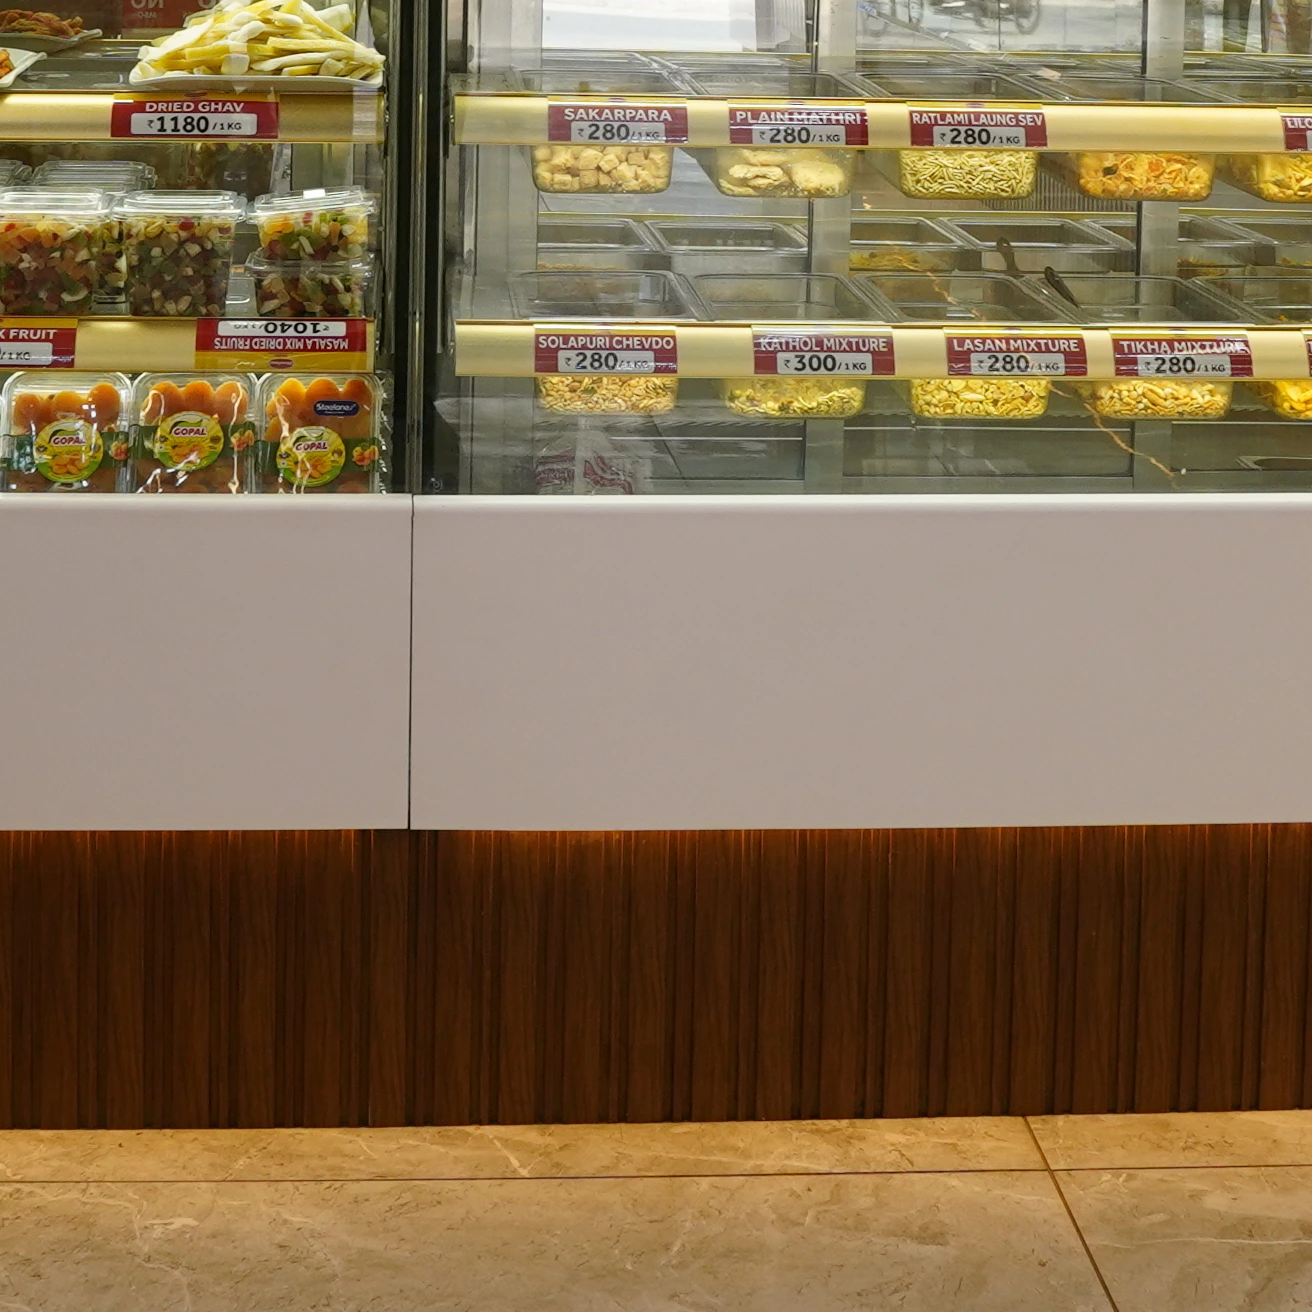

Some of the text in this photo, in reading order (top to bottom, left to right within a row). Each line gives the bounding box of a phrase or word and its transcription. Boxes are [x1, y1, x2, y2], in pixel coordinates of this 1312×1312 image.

[145, 102, 245, 112] DRIED GHAV
[563, 108, 673, 121] SAKARPARA
[736, 111, 861, 124] PLAIN MATHRI
[912, 113, 1043, 126] RATLAMI LAUNG SEV
[9, 329, 58, 340] FRUIT
[214, 338, 349, 350] MASALA MIX DRIED FRUITS
[538, 336, 675, 349] SOLAPURI CHEVDO
[760, 338, 888, 351] KATHOL MIXTURE
[953, 339, 1080, 352] LASAN MIXTURE
[1120, 341, 1171, 353] TIKHA
[172, 427, 207, 438] GOPAL
[52, 435, 86, 445] GOPAL
[294, 441, 328, 451] GOPAL
